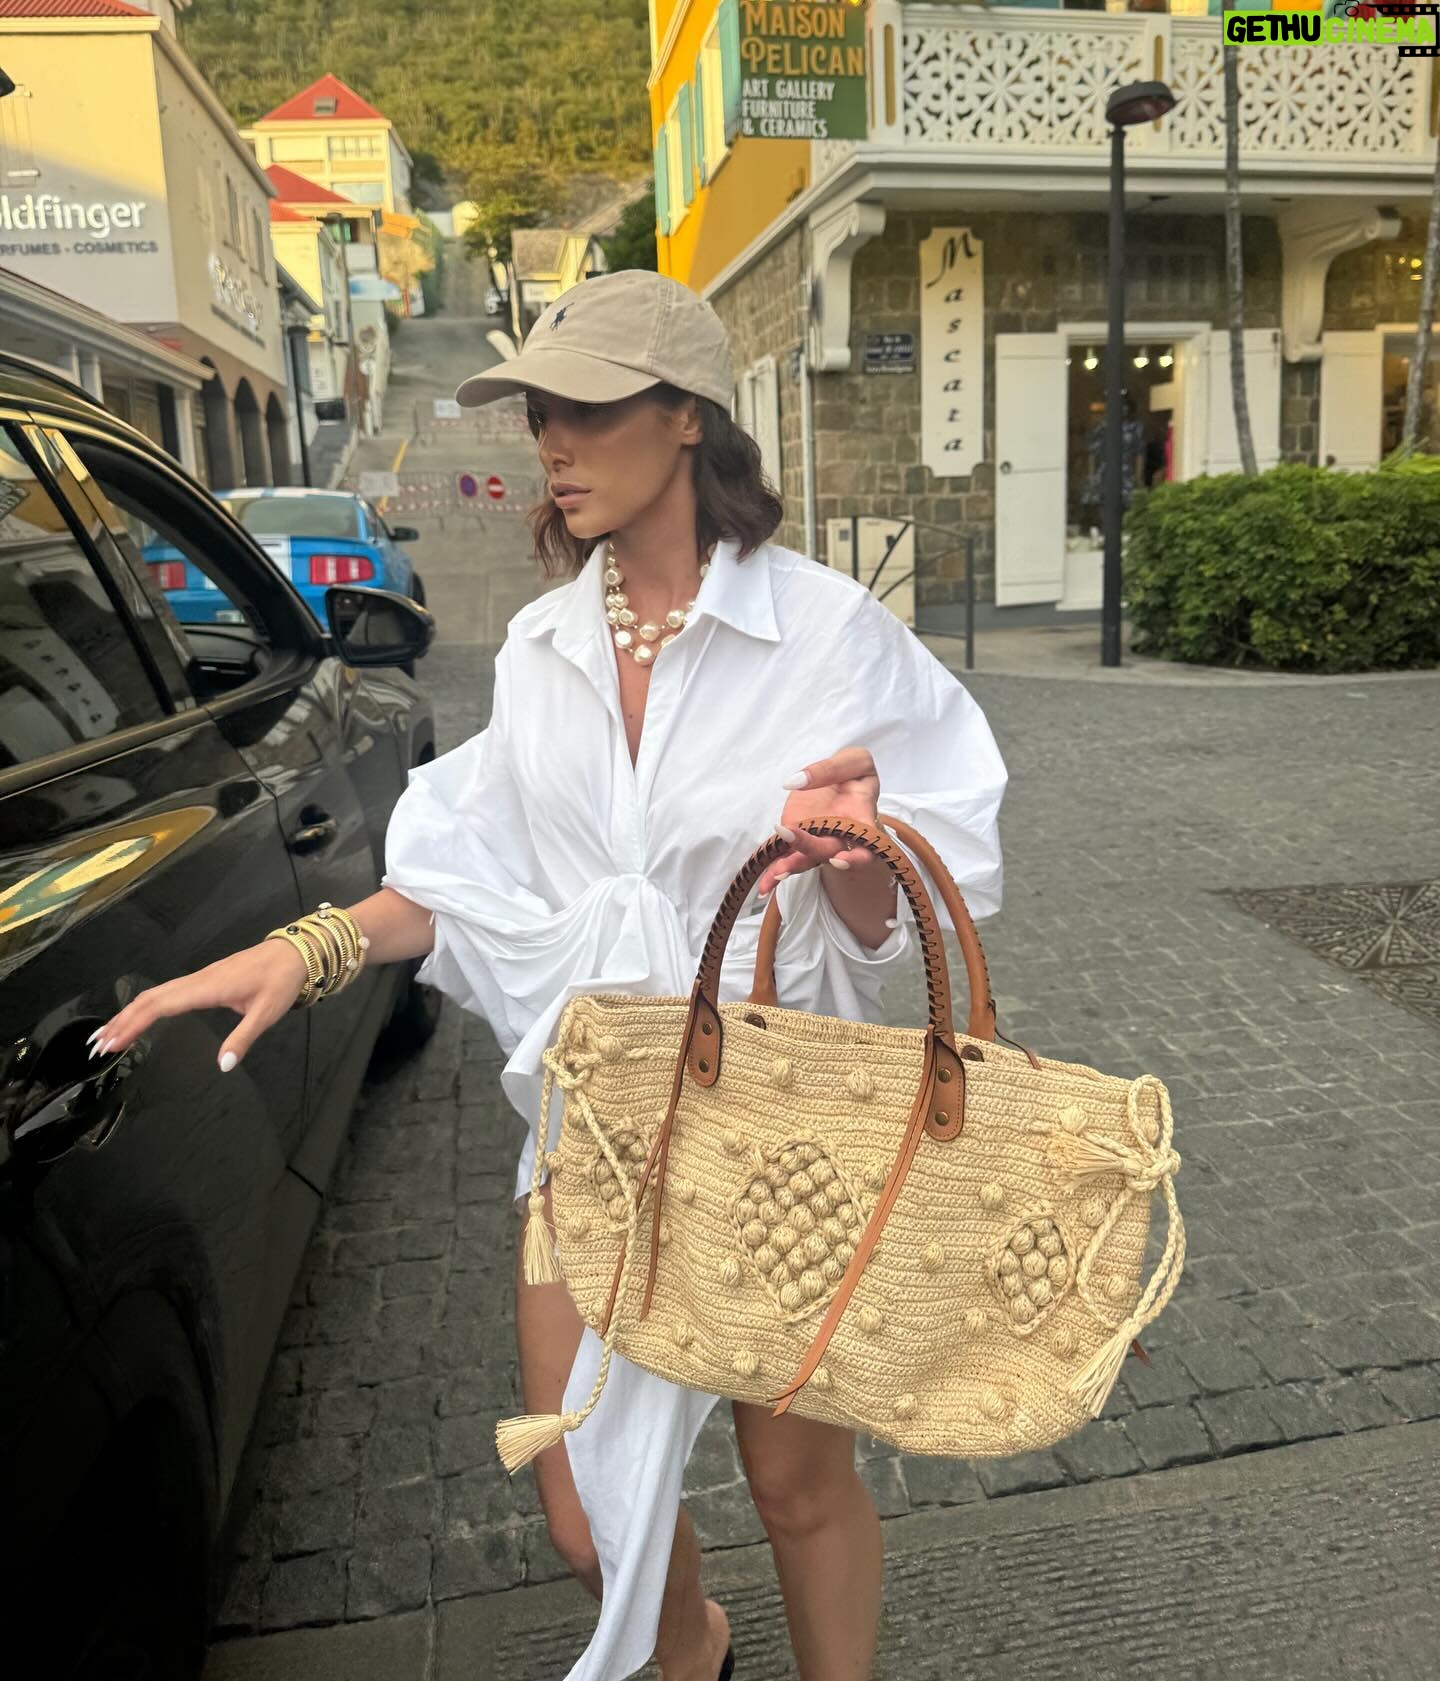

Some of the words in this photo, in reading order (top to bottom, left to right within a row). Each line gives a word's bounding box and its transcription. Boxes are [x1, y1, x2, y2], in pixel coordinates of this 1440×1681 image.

[740, 0, 846, 38] MAISON
[741, 36, 864, 76] PELICAN
[742, 79, 769, 98] ART
[775, 79, 836, 101] GALLERY
[742, 100, 817, 119] FURNITURE
[742, 118, 755, 135] &
[760, 118, 829, 138] CERAMICS
[0, 193, 146, 239] ldfinger
[73, 240, 159, 255] COSMETICS
